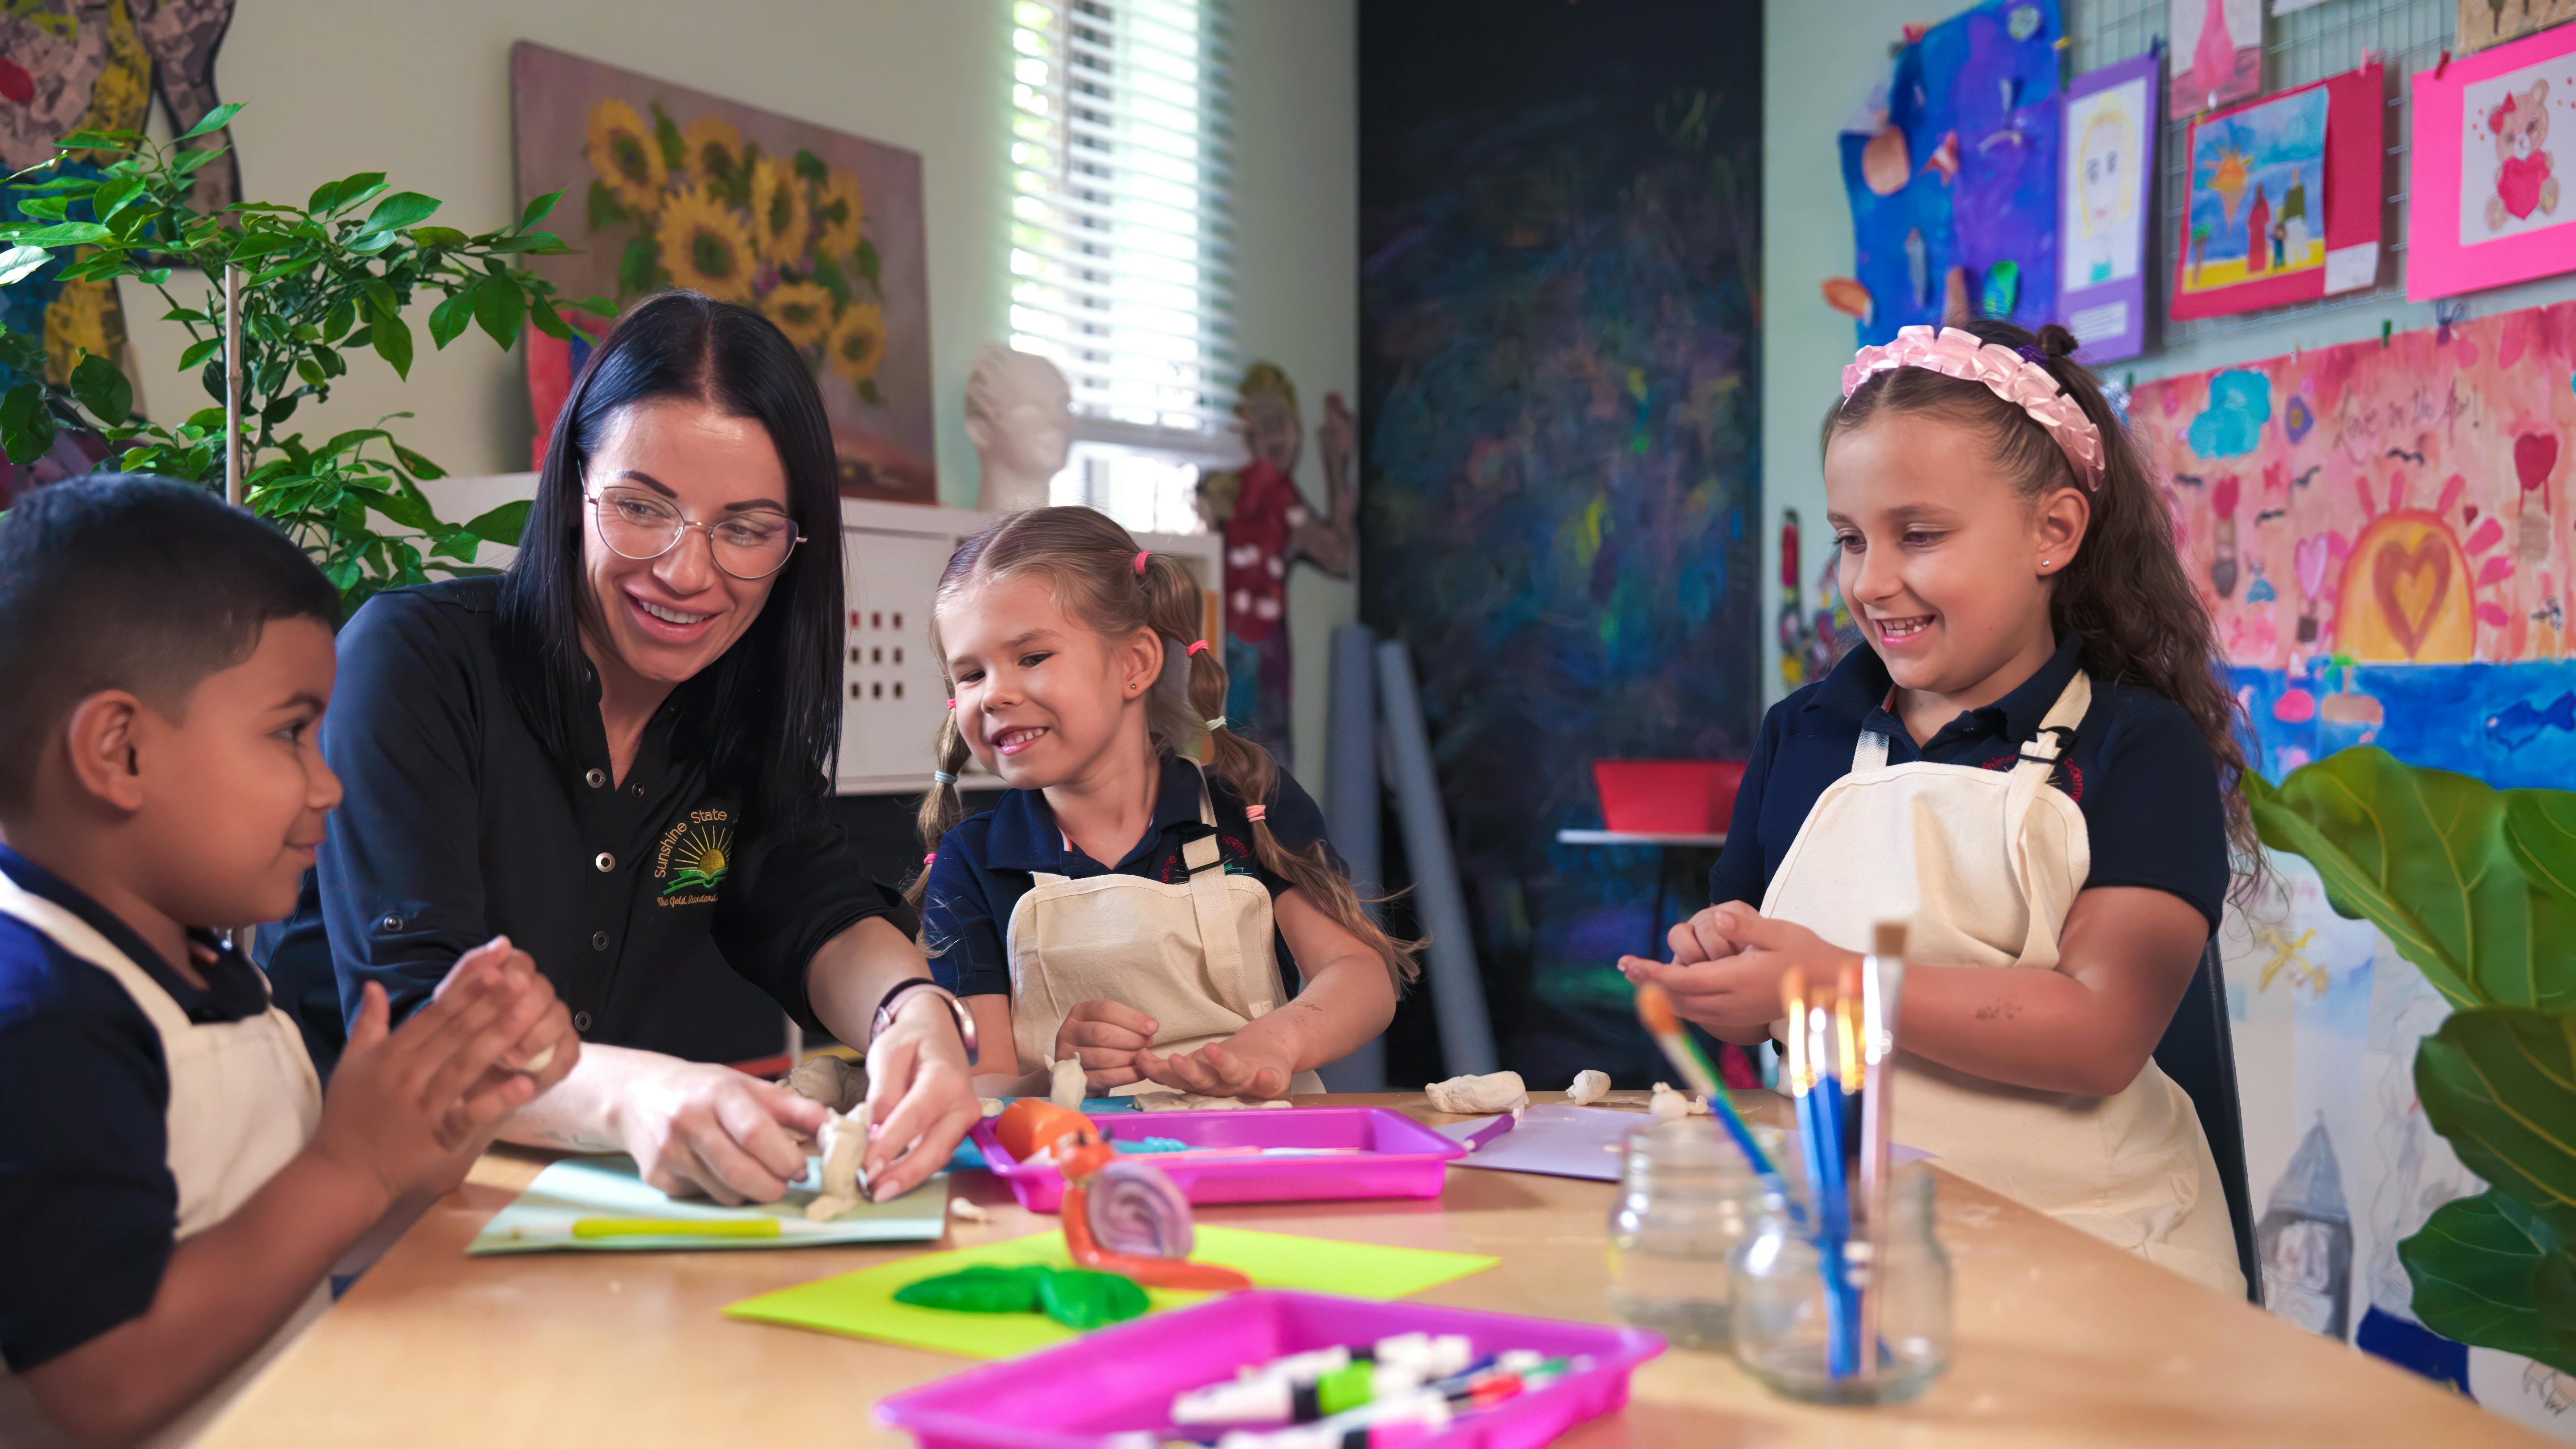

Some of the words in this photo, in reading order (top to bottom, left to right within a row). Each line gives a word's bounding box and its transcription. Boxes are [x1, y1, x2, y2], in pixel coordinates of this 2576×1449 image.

[2063, 758, 2083, 802] cademy
[654, 822, 687, 878] Sunshine
[691, 809, 727, 823] State
[657, 897, 669, 907] The
[669, 895, 687, 908] Gold
